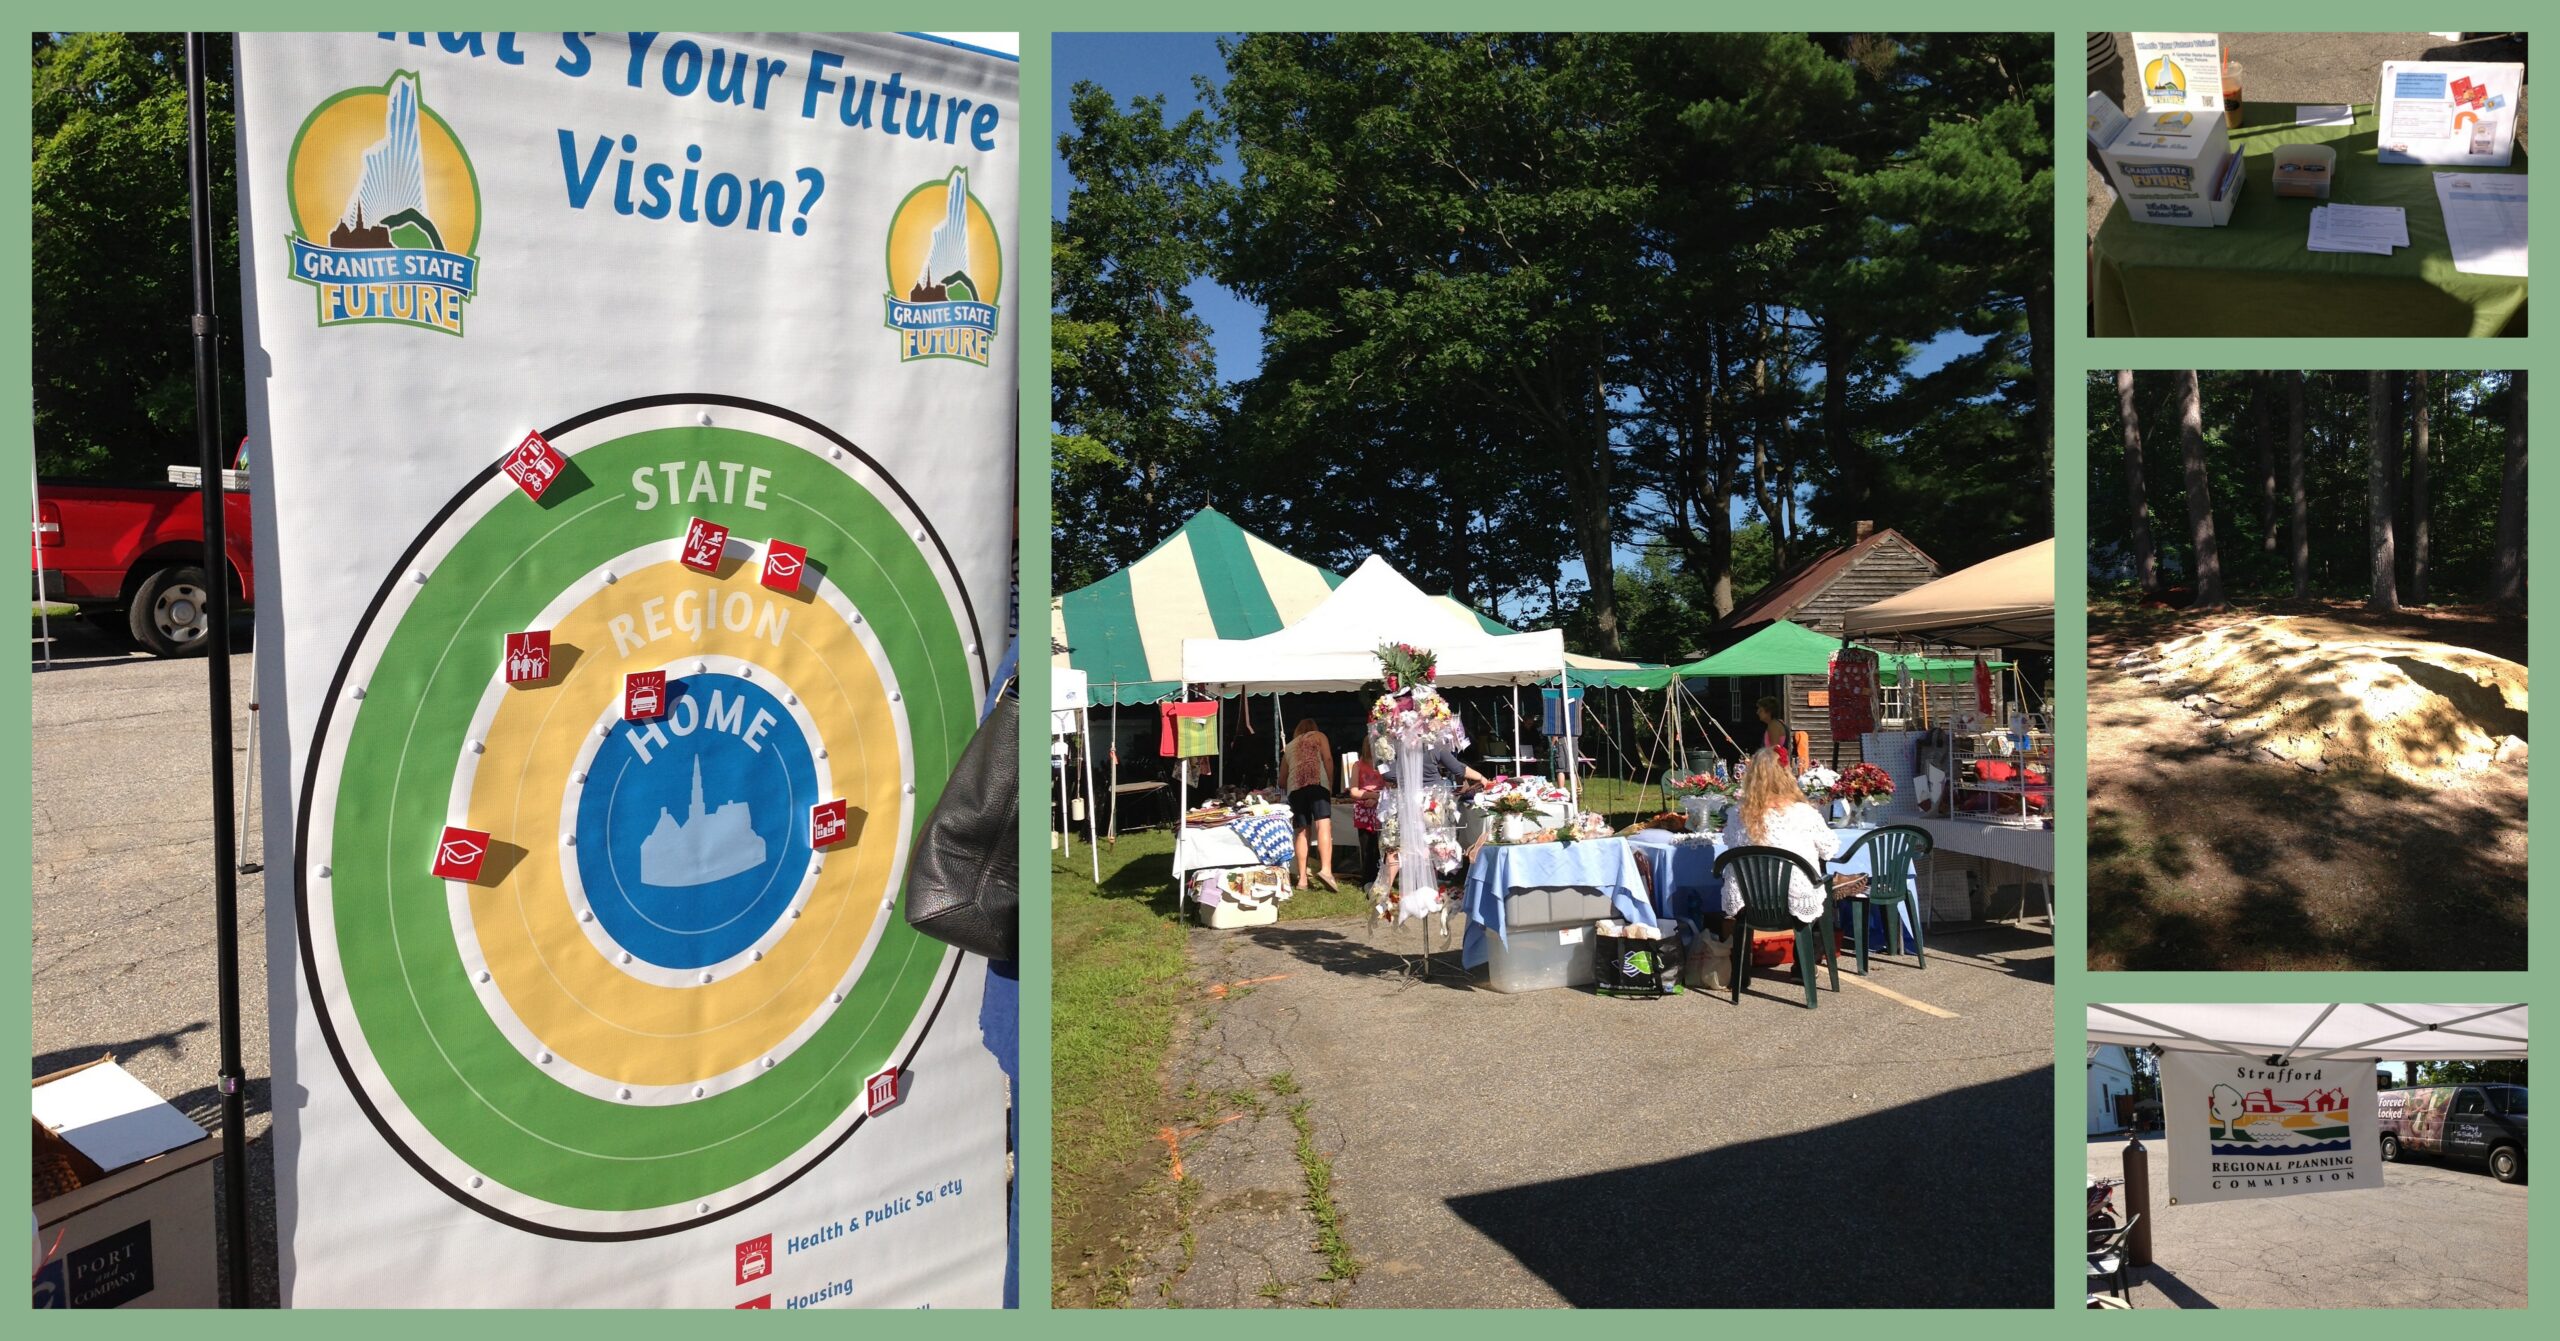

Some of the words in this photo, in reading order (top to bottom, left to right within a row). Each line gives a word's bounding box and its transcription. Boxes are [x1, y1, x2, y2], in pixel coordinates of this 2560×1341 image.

[623, 32, 786, 112] Your
[801, 49, 1000, 153] Future
[557, 128, 827, 237] Vision?
[2132, 174, 2190, 191] FUTURE
[2161, 167, 2188, 176] STATE
[304, 252, 400, 278] GRANITE
[404, 255, 465, 283] STATE
[322, 284, 461, 333] FUTURE
[893, 306, 952, 326] GRANITE
[954, 306, 992, 326] STATE
[903, 329, 988, 364] FUTURE
[631, 461, 773, 511] STATE
[608, 588, 790, 658] REGION
[625, 689, 778, 765] HOME
[2237, 1067, 2322, 1083] Strafford
[2378, 1108, 2403, 1120] Locked
[2212, 1160, 2282, 1173] REGIONAL
[2287, 1156, 2353, 1170] PLANNING
[2212, 1172, 2355, 1189] COMMISSION
[787, 1222, 843, 1255] Health
[849, 1217, 860, 1232] &
[865, 1197, 912, 1227] Public
[916, 1179, 963, 1206] Saety
[77, 1243, 134, 1279] PORT
[75, 1270, 137, 1305] COMPANY
[786, 1278, 854, 1310] Housing
